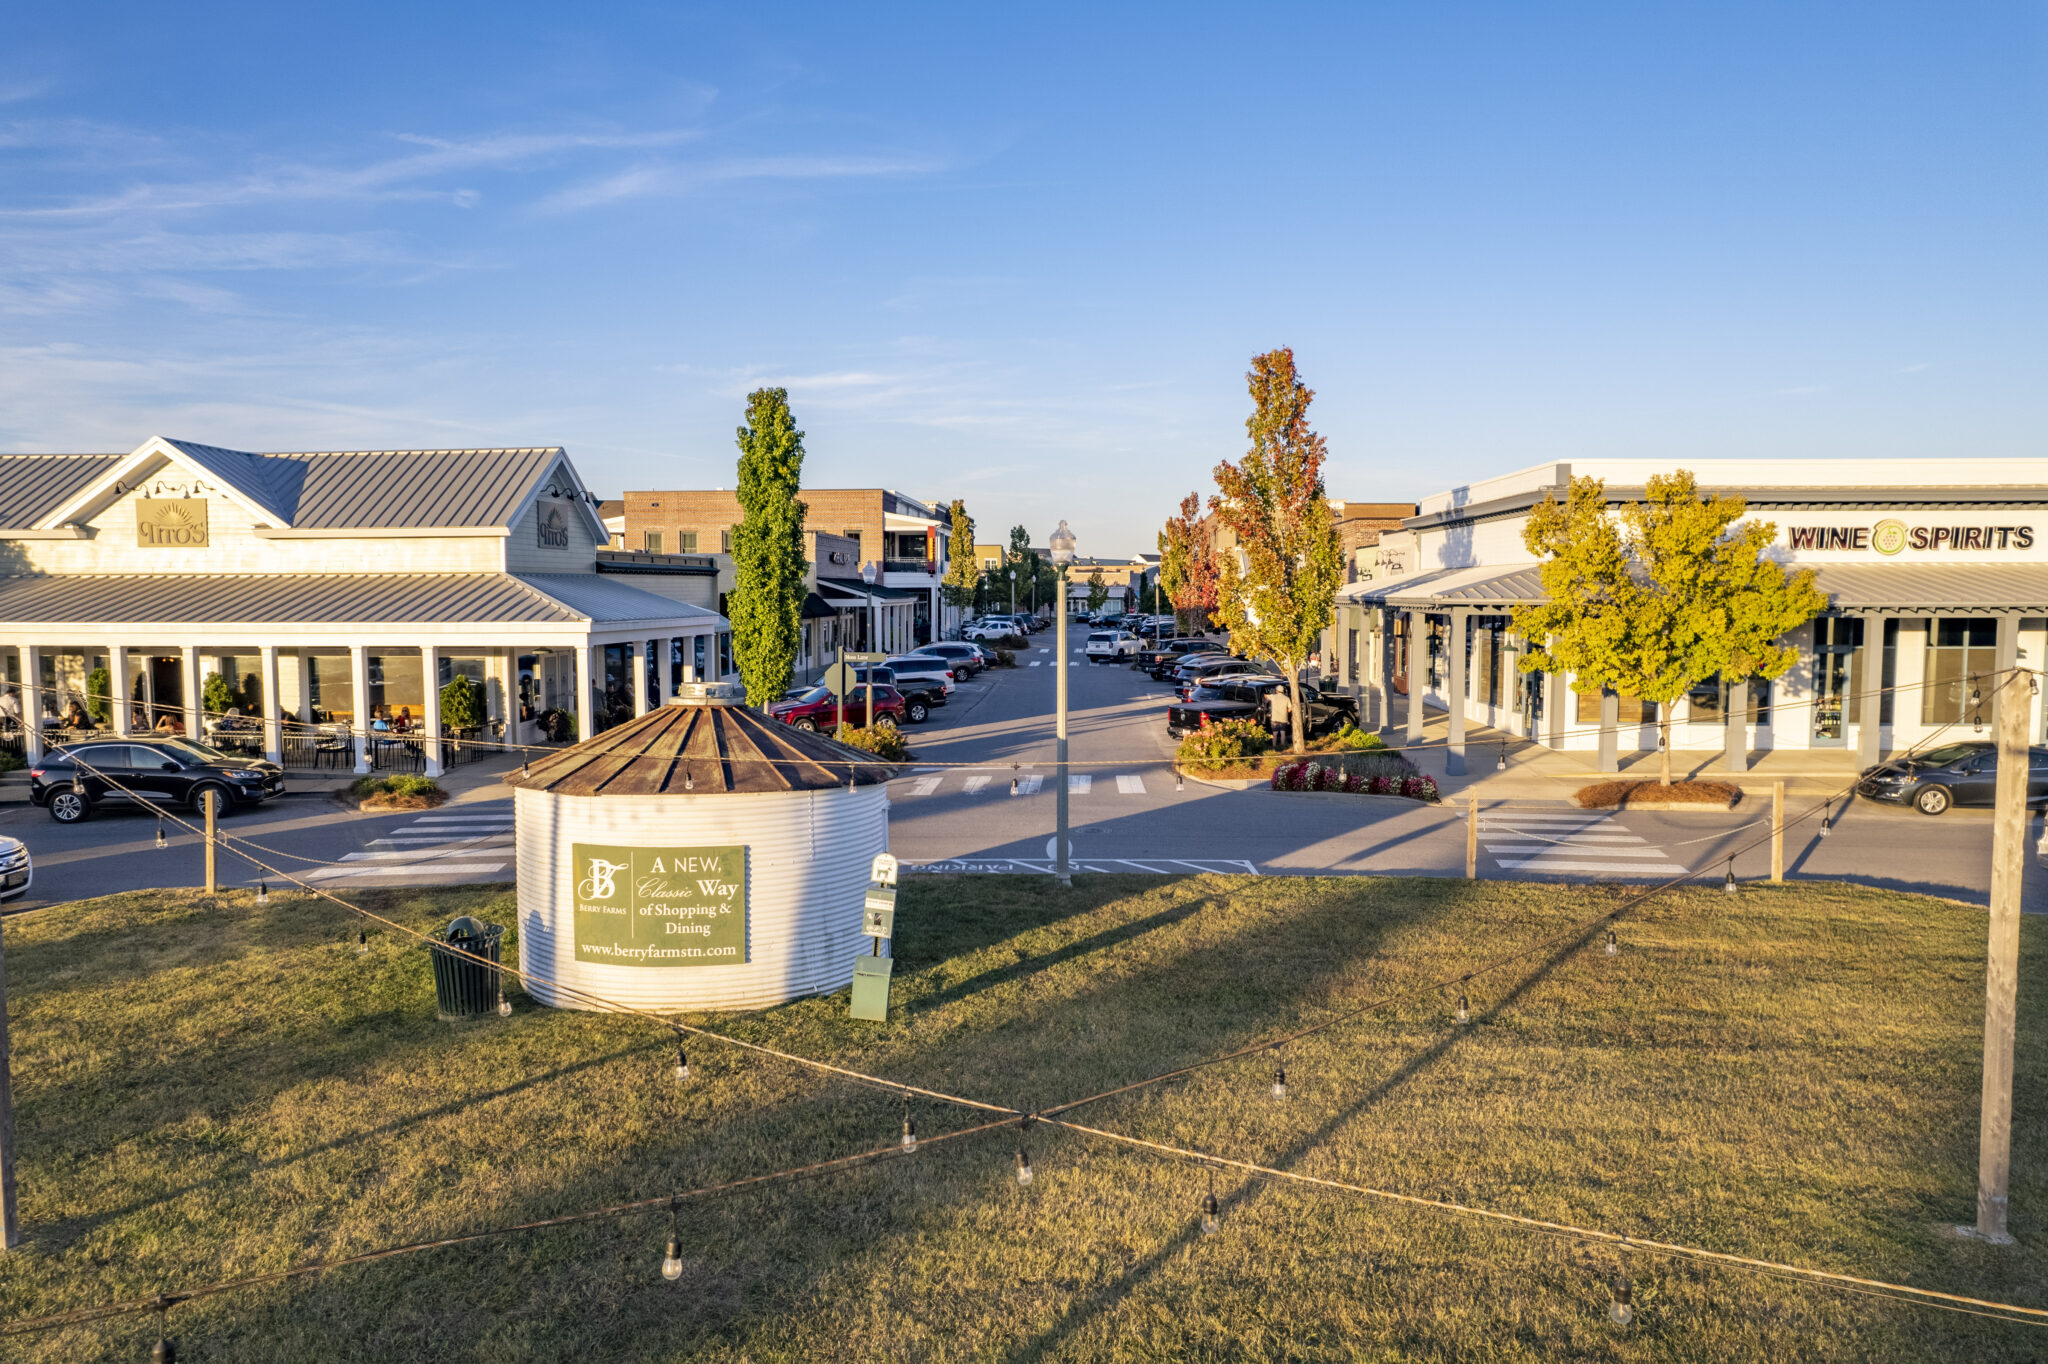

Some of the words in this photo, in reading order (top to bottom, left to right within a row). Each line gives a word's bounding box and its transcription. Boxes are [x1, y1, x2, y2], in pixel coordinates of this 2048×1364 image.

[140, 521, 206, 544] TITO'S
[1788, 526, 1870, 550] WINE
[1908, 526, 2034, 550] SPIRITS
[651, 856, 667, 873] A
[674, 856, 722, 873] NEW,
[910, 863, 1014, 872] PARKING
[636, 876, 694, 898] Classic
[697, 879, 739, 900] Way
[579, 903, 601, 913] BERRY
[603, 905, 627, 915] FARMS
[639, 903, 655, 916] of
[655, 904, 717, 919] Shopping
[719, 903, 732, 914] &
[665, 922, 711, 937] Dining
[582, 942, 736, 961] www.berryfarmstn.com
